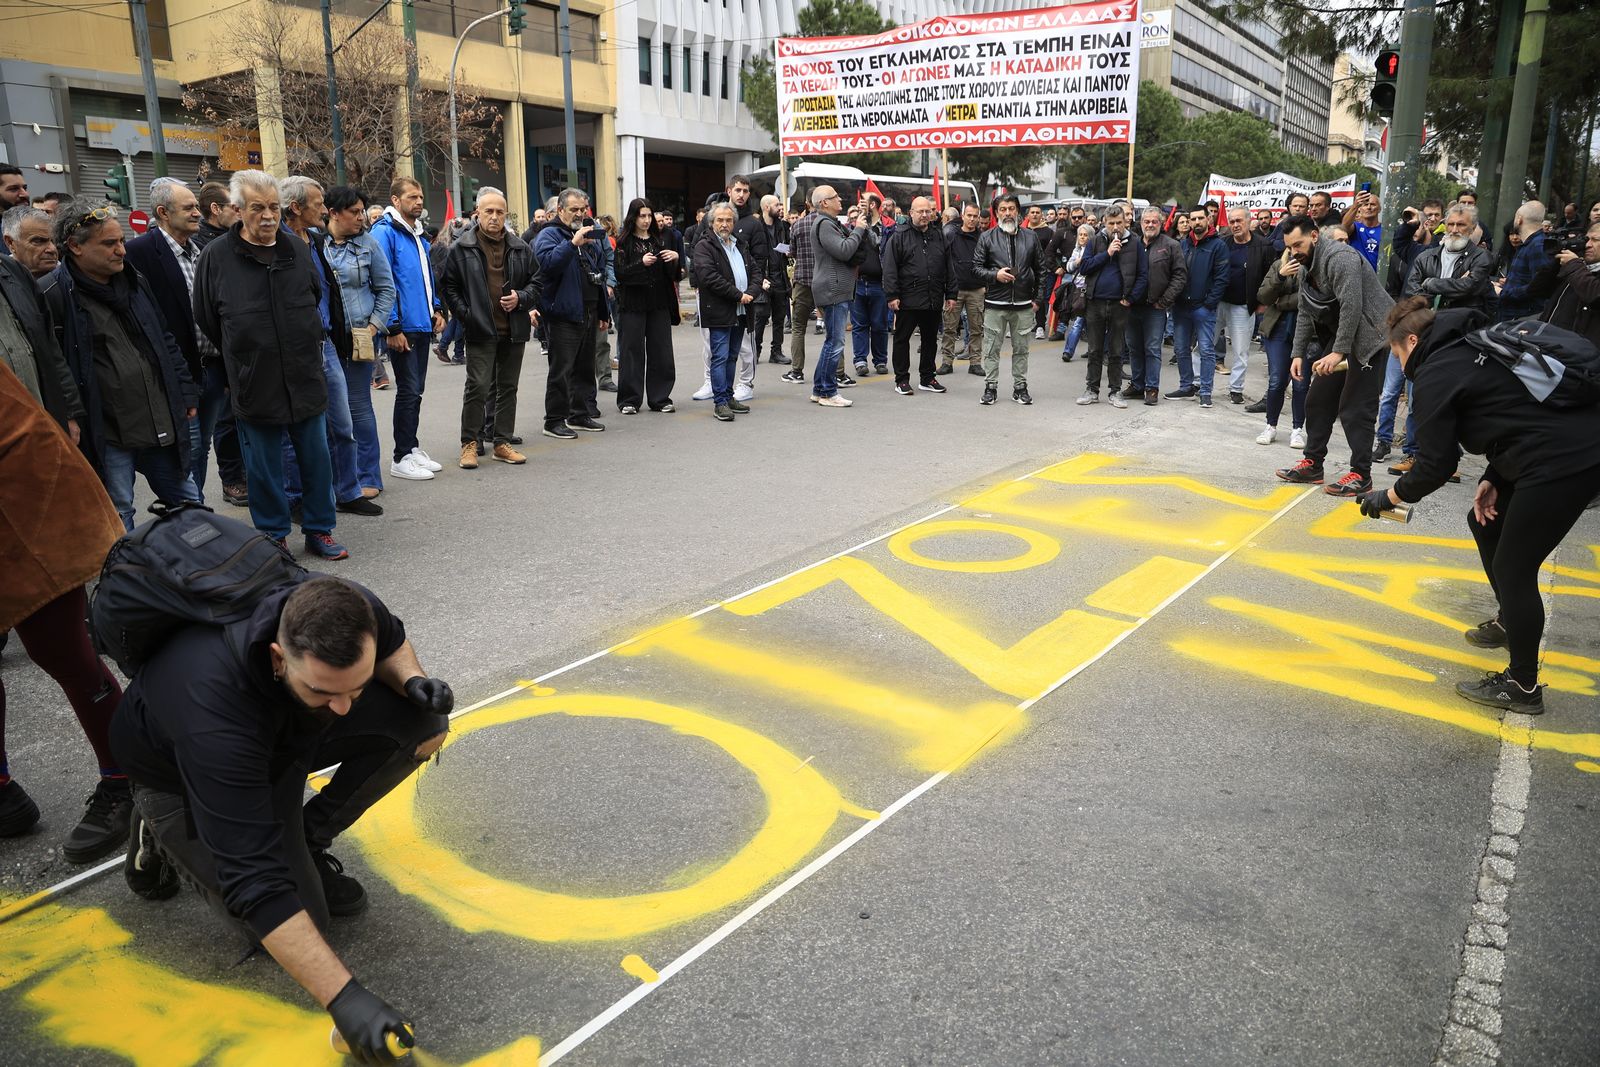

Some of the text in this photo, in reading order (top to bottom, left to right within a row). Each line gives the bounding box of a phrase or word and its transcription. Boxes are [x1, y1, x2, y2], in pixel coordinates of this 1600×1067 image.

[897, 16, 1019, 42] ΟΙΚΟΔΟΜΩΝ
[1023, 5, 1132, 30] ΕΛΛΑΔΑΣ
[1142, 24, 1169, 38] RON
[782, 31, 1131, 77] ΕΝΟΧΟΣ ΤΟΥ ΕΓΚΛΗΜΑΤΟΣ ΣΤΑ ΤΕΜΠΗ ΕΙΝΑΙ
[783, 81, 798, 94] ΤΑ
[801, 77, 838, 92] ΚΕΡΔΗ
[842, 74, 873, 89] ΤΟΥΣ
[881, 71, 895, 86] ΟΙ
[900, 64, 951, 84] ΑΓΩΝΕΣ
[954, 62, 985, 78] ΜΑΣ
[990, 61, 1000, 75] Η
[1006, 55, 1082, 75] ΚΑΤΑΔΙΚΗ
[1087, 52, 1130, 70] ΤΟΥΣ
[793, 96, 836, 113] ΠΡΟΣΤΑΣΙΑ
[837, 94, 854, 110] ΤΗΣ
[855, 89, 912, 108] ΑΝΘΡΩΠΙΝΗΣ
[914, 86, 939, 103] ΖΩΗΣ
[968, 80, 1008, 99] ΧΩΡΟΥΣ
[1010, 77, 1060, 97] ΔΟΥΛΕΙΑΣ
[1063, 76, 1081, 94] ΚΑΙ
[1084, 74, 1130, 92] ΠΑΝΤΟΥ
[793, 108, 929, 131] ΑΥΞΗΣΕΙΣ ΣΤΑ ΜΕΡΟΚΑΜΑΤΑ
[945, 97, 1128, 121] ΜΕΤΡΑ ΕΝΑΝΤΙΑ ΣΤΗΝ ΑΚΡΙΒΕΙΑ
[783, 124, 1127, 153] ΣΥΝΔΙΚΑΤΟ ΟΙΚΟΔΟΜΩΝ ΑΘΗΝΑΣ
[1238, 188, 1282, 197] ΚΑΤΑΡΓΗΣΗ
